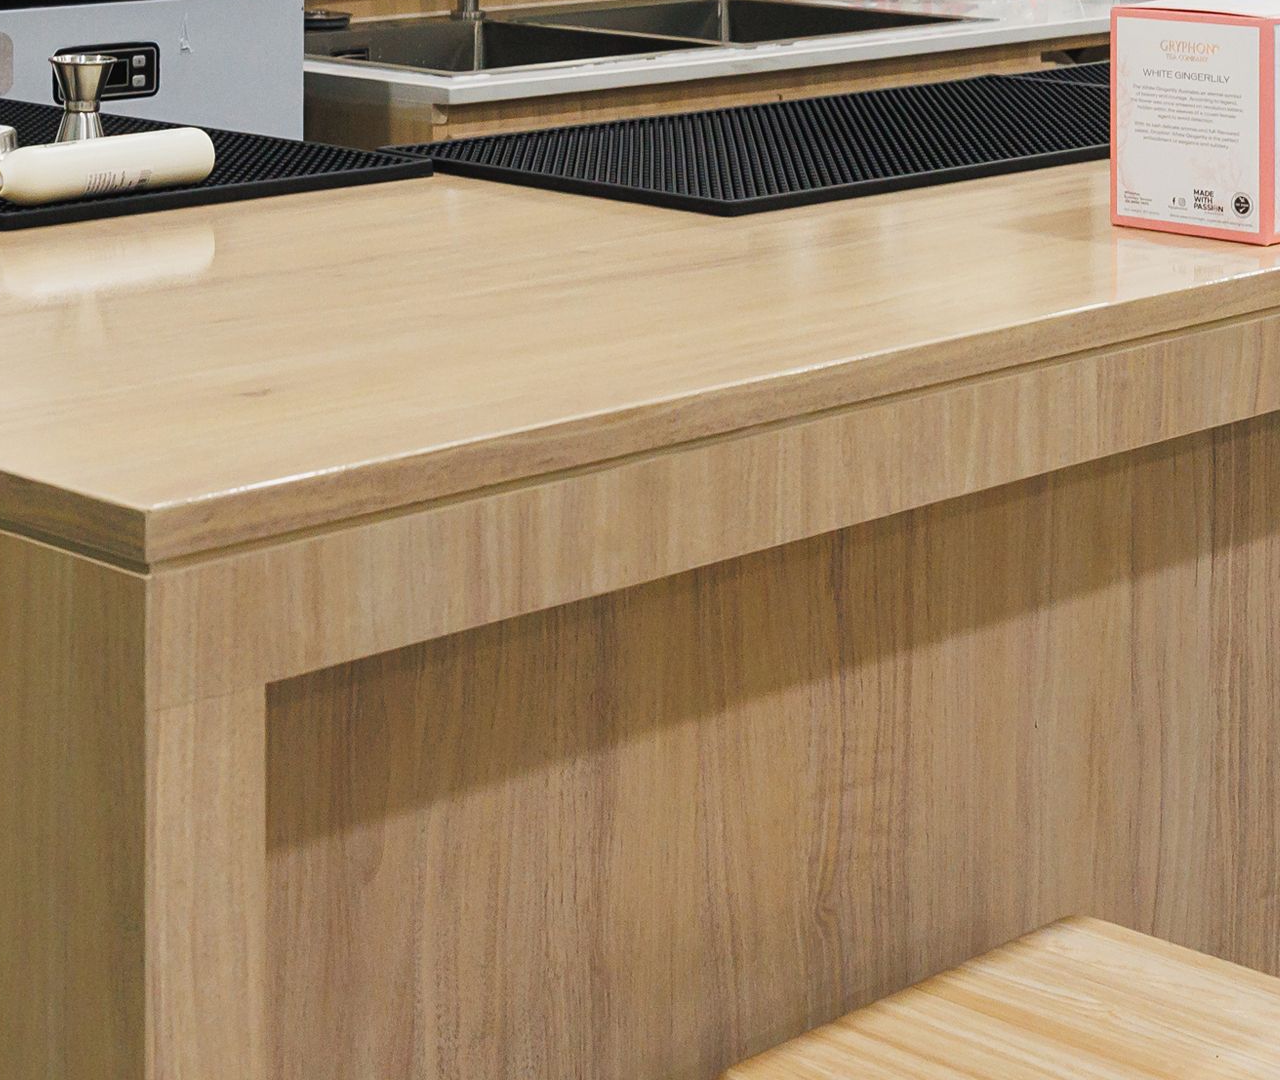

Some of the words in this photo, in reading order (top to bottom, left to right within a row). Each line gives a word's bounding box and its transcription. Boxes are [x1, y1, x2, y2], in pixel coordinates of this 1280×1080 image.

[1160, 39, 1217, 55] GRYPHON
[1142, 67, 1173, 79] WHITE
[1174, 70, 1230, 84] GINGERLILY
[1193, 188, 1214, 198] MADE
[1194, 196, 1213, 204] WITH
